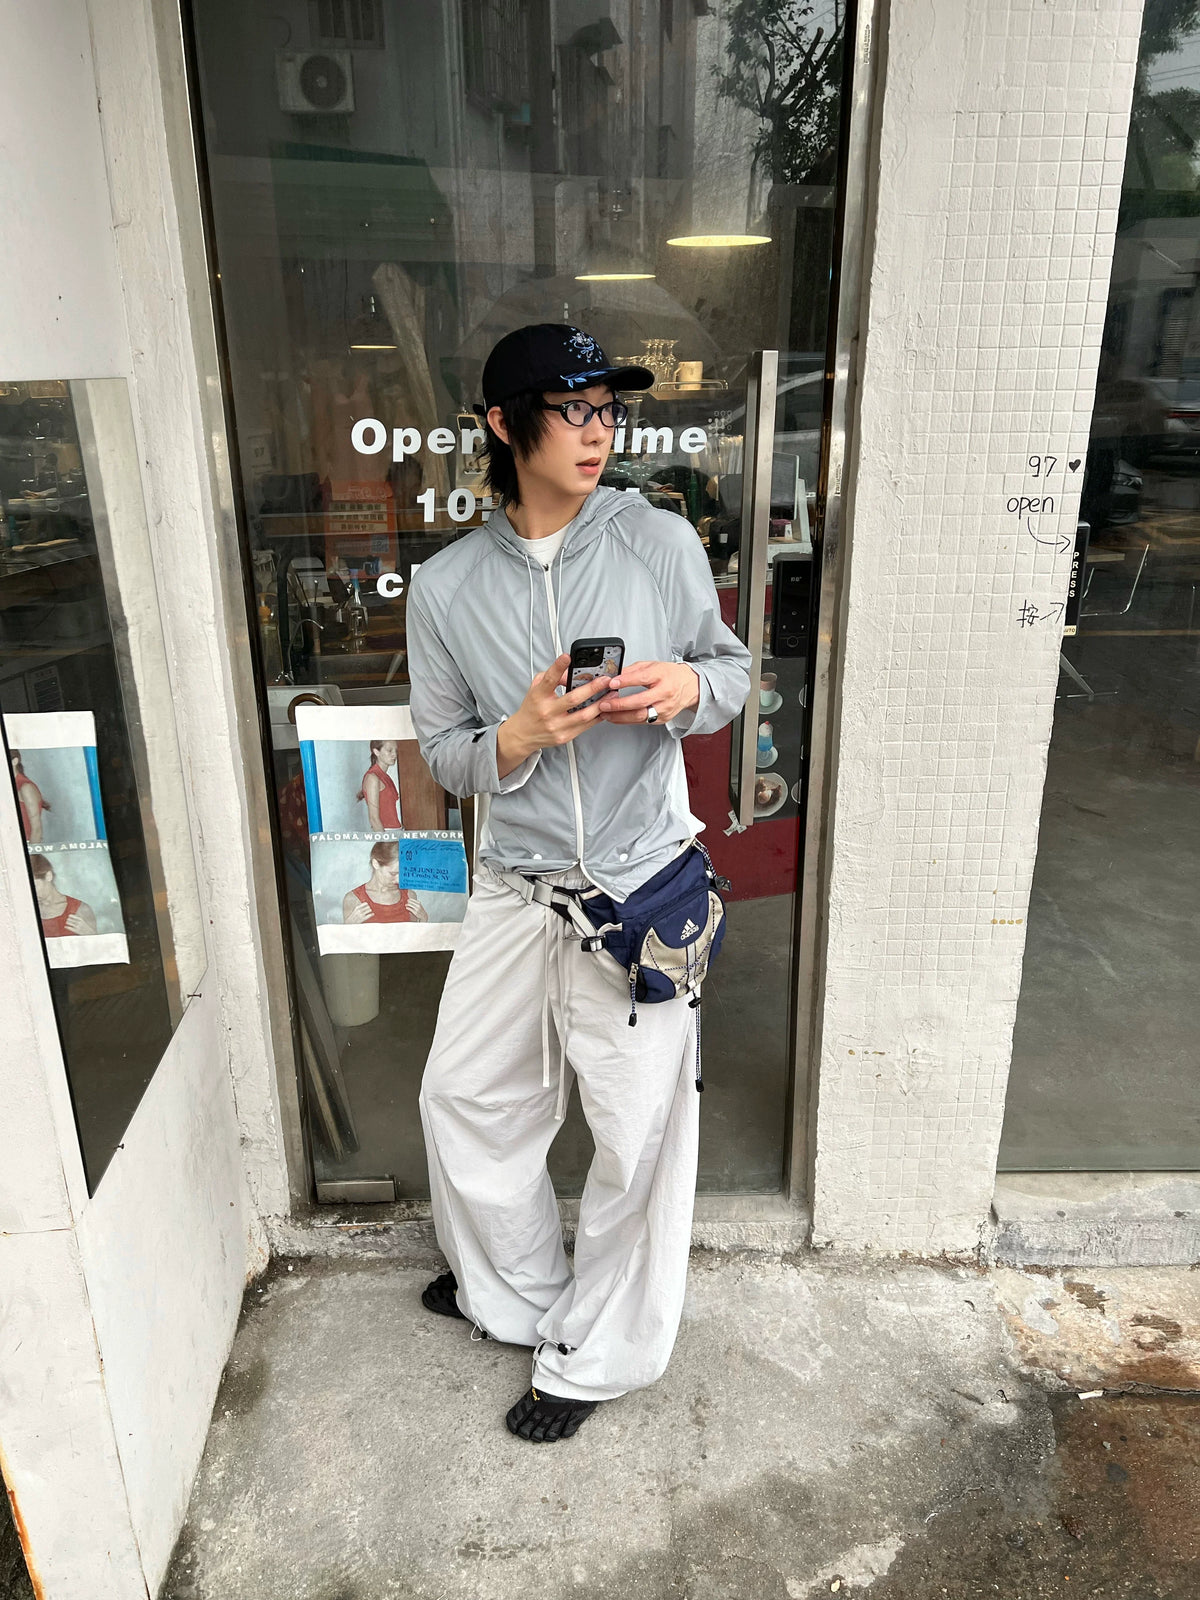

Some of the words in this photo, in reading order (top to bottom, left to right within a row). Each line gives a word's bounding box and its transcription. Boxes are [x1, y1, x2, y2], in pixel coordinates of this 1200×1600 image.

[613, 416, 708, 454] ime
[1028, 456, 1057, 477] 97
[416, 488, 493, 523] 10:
[1006, 496, 1054, 520] open
[1068, 551, 1080, 598] PRESS
[1016, 599, 1039, 628] 按
[312, 832, 360, 842] PALOMA
[364, 833, 398, 841] WOOL
[403, 832, 428, 840] NEW
[433, 831, 464, 839] YORK
[680, 924, 700, 941] adidas
